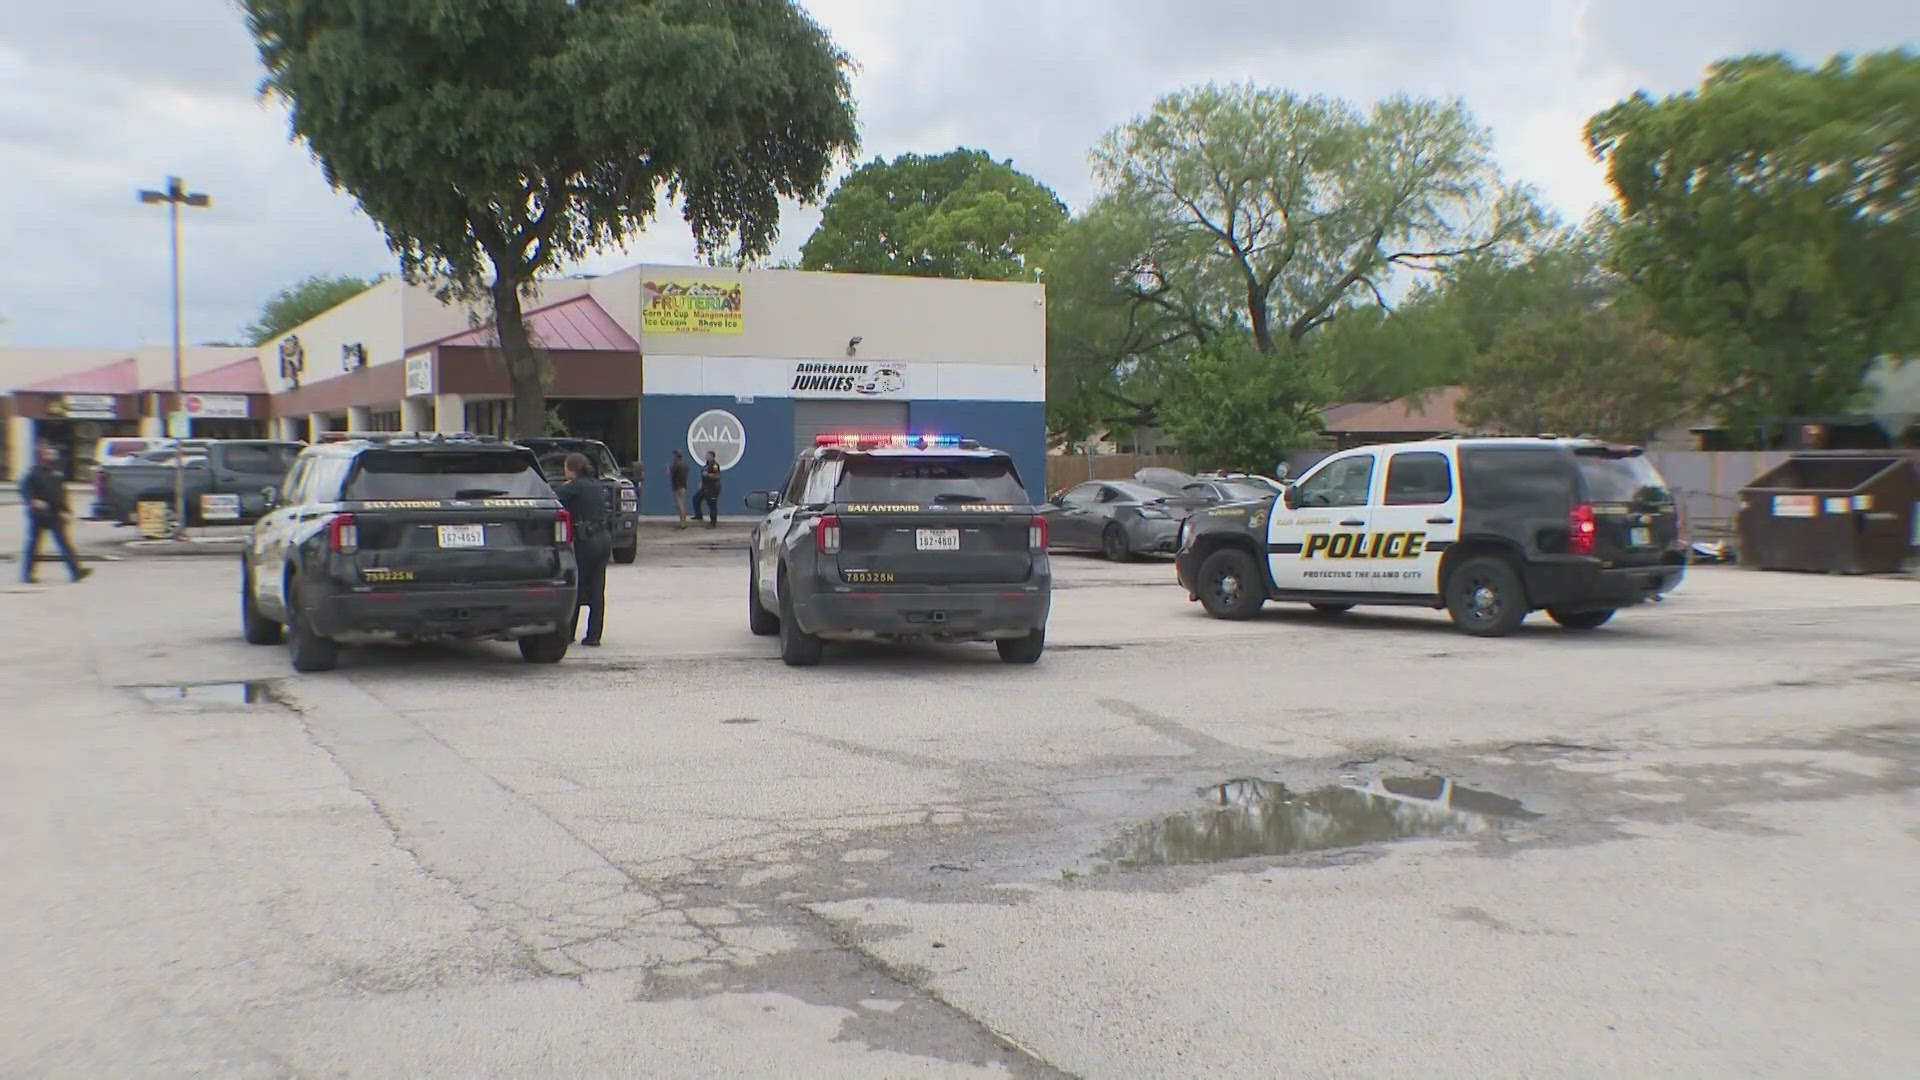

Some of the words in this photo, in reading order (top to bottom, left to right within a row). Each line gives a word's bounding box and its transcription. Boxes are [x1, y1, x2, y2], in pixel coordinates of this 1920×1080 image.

[651, 294, 733, 312] FRUTERIA
[673, 309, 689, 318] Cup
[645, 318, 658, 326] Ice
[660, 318, 687, 326] Cream
[698, 319, 722, 328] Shave
[724, 319, 738, 328] Ice
[796, 363, 869, 374] ADRENALINE
[791, 375, 855, 392] JUNKIES
[483, 499, 538, 507] POLICE
[847, 504, 869, 512] SAN
[870, 504, 920, 512] ANTONIO
[960, 504, 1014, 512] POLICE
[1301, 532, 1426, 560] POLICE
[1372, 571, 1399, 579] ALAMO
[1402, 571, 1422, 579] CITY
